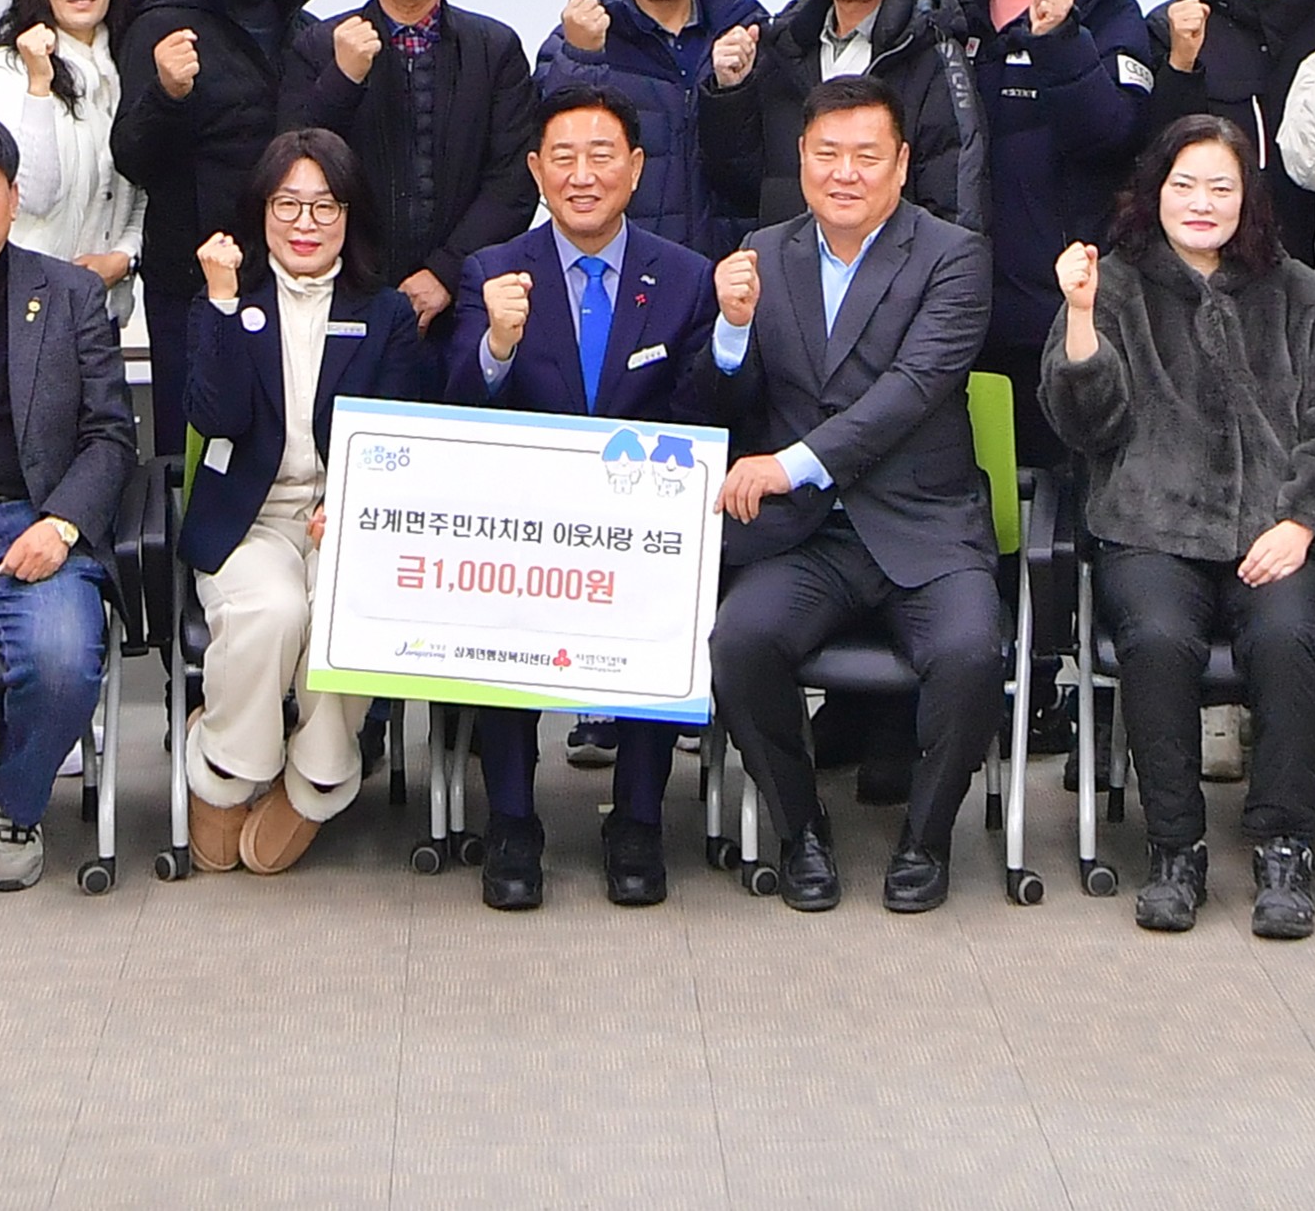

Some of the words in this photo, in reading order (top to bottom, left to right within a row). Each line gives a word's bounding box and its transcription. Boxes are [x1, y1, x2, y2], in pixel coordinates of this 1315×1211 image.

[358, 506, 543, 544] 삼계면주민자치회
[553, 522, 634, 552] 이웃사랑
[642, 529, 683, 555] 성금
[396, 554, 615, 604] 금1,000,000원
